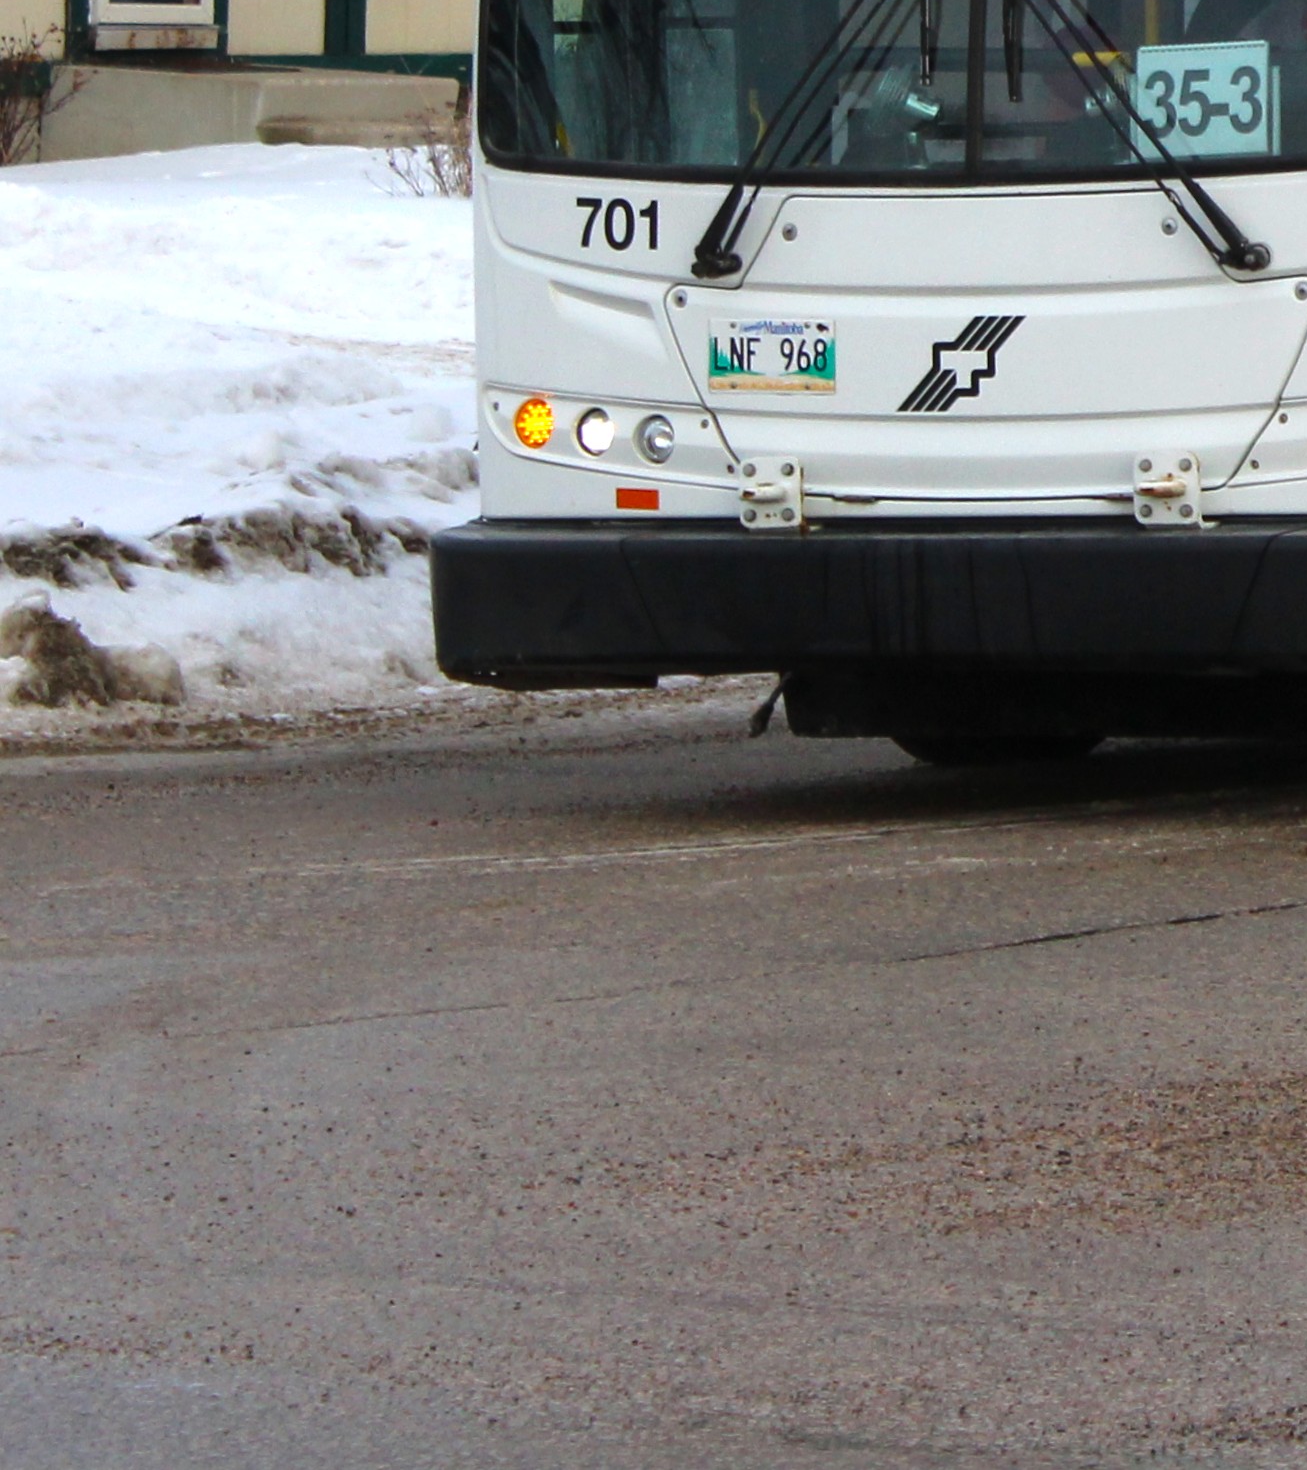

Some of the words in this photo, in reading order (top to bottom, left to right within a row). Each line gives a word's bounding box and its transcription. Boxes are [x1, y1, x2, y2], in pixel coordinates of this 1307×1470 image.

[1144, 65, 1263, 139] 35-3
[576, 197, 658, 250] 701
[713, 336, 761, 372] LNF
[780, 337, 828, 373] 968
